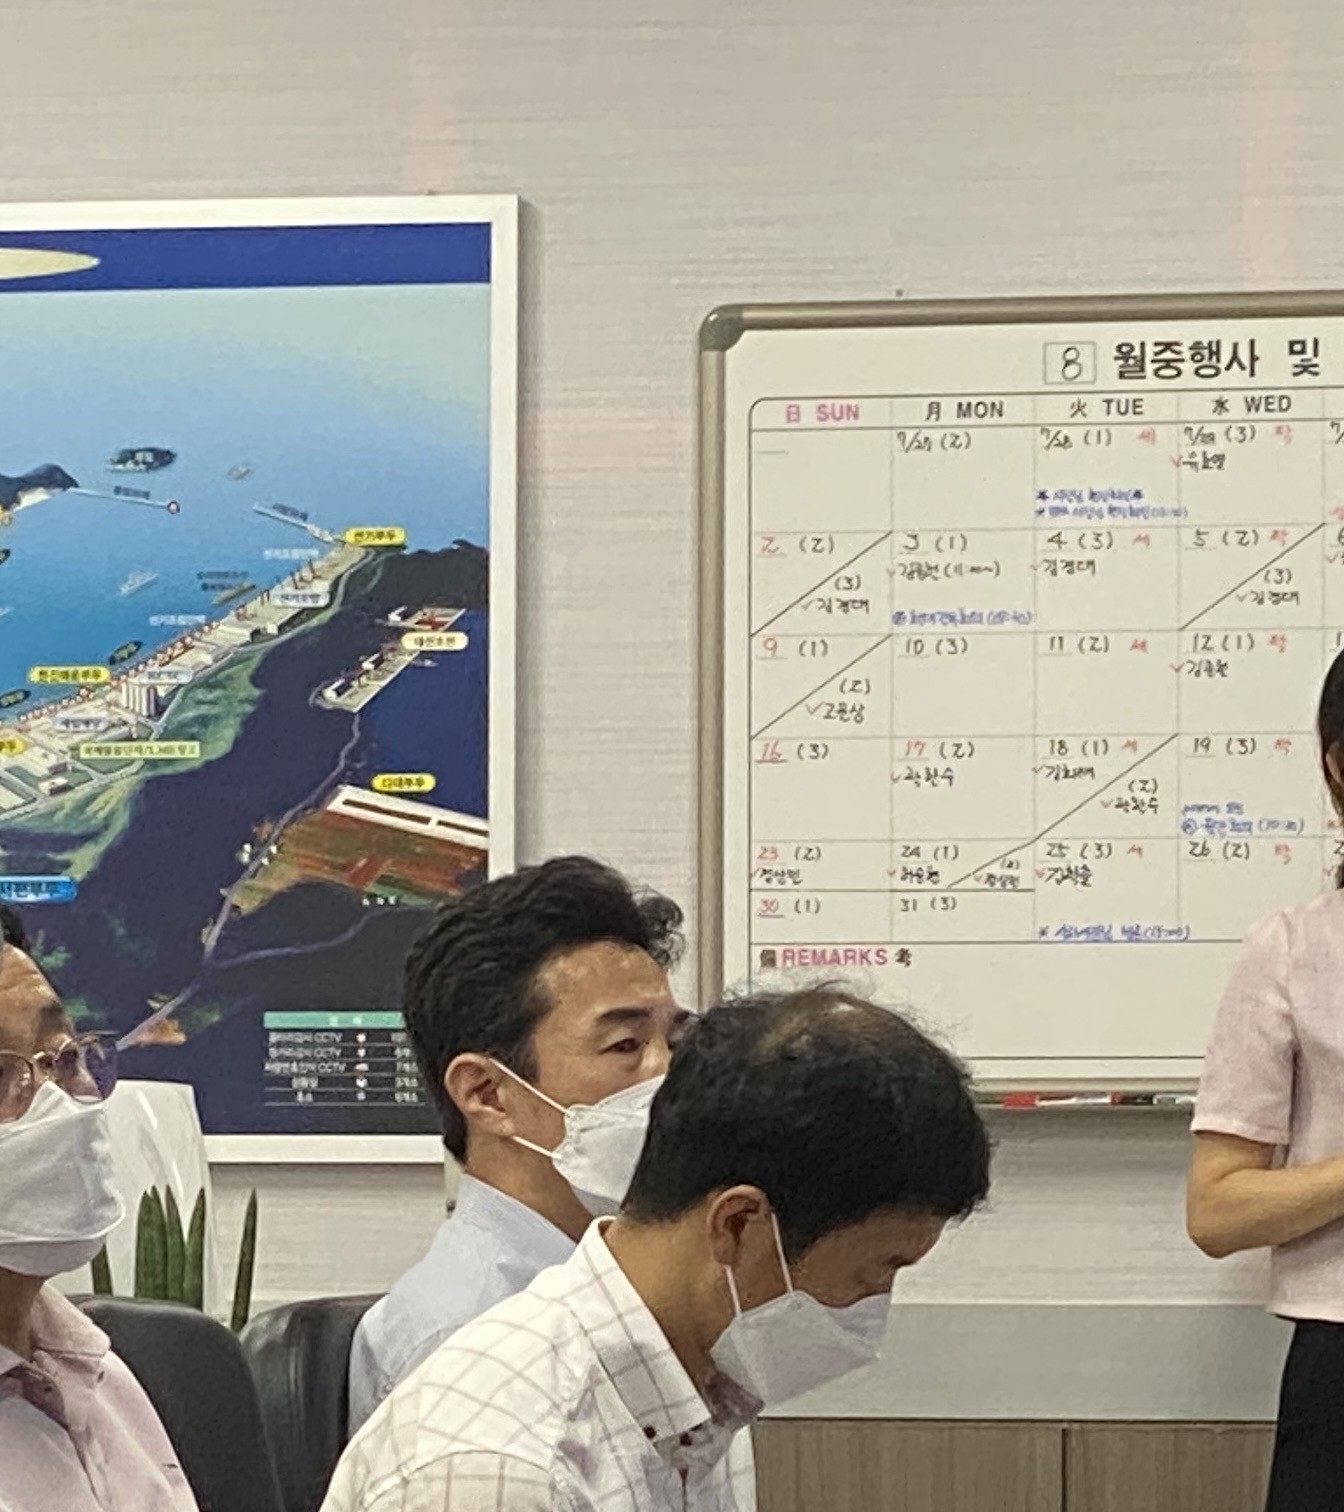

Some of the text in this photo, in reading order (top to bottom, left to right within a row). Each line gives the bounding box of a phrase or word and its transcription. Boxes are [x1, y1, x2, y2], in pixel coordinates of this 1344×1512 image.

[1061, 347, 1083, 381] 8
[1113, 339, 1260, 380] 월중행사
[1288, 336, 1321, 377] 및
[786, 403, 859, 423] 日 SUN
[925, 400, 1004, 421] 月 MON
[1070, 398, 1145, 418] 火 TUE
[1212, 395, 1292, 414] 水 WED
[940, 431, 973, 450] (2)
[1084, 428, 1112, 447] (1)
[1225, 425, 1257, 443] (3)
[799, 536, 836, 554] (2)
[936, 533, 968, 552] (1)
[1046, 531, 1068, 549] 4
[1078, 530, 1114, 550] (3)
[1193, 529, 1260, 547] 5 (2)
[835, 574, 861, 591] (3)
[1264, 569, 1292, 585] (3)
[763, 638, 829, 658] 9 (1)
[906, 637, 968, 656] 10 (3)
[1049, 636, 1064, 652] 11
[1078, 635, 1110, 654] (2)
[1193, 632, 1255, 652] 12 (1)
[839, 678, 871, 695] (2)
[797, 742, 829, 760] (3)
[905, 740, 975, 759] 17 (2)
[1050, 739, 1068, 755] 18
[1082, 738, 1109, 757] (1)
[1193, 738, 1257, 756] 19 (3)
[1128, 779, 1159, 795] (2)
[757, 846, 821, 861] 23 (2)
[933, 845, 959, 861] (1)
[1046, 843, 1070, 859] 25
[1079, 842, 1113, 859] (3)
[1189, 841, 1251, 860] 26 (2)
[794, 898, 820, 914] (1)
[900, 897, 957, 912] 31 (3)
[782, 948, 888, 966] REMARKS
